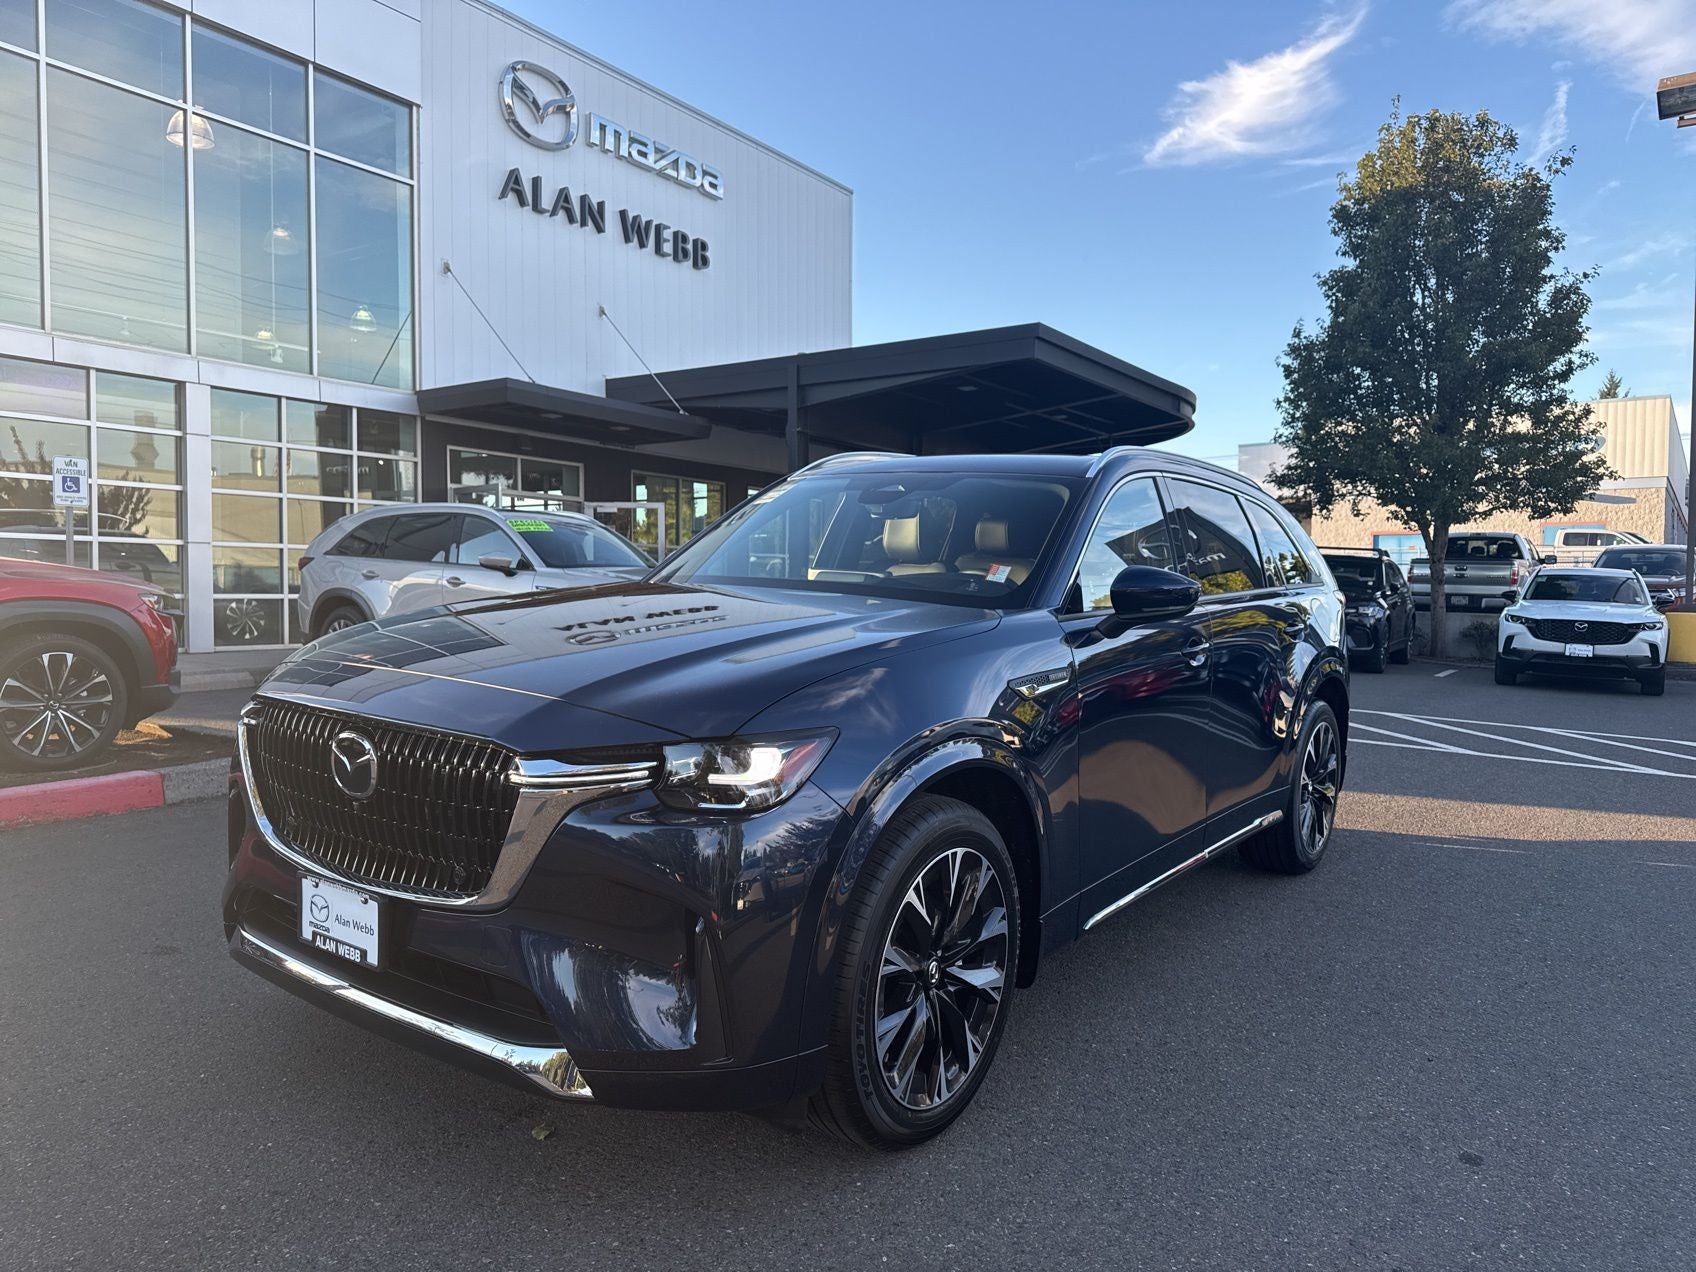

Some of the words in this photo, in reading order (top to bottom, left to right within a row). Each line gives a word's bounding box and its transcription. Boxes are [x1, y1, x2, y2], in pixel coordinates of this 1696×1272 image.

[499, 167, 605, 234] ALAN
[619, 208, 710, 270] WEBB
[55, 468, 86, 476] ACCESSIBLE
[64, 460, 78, 468] VAN
[334, 913, 351, 928] Alan
[352, 919, 375, 936] Webb
[315, 934, 336, 953] ALAN
[337, 942, 361, 963] WEBB
